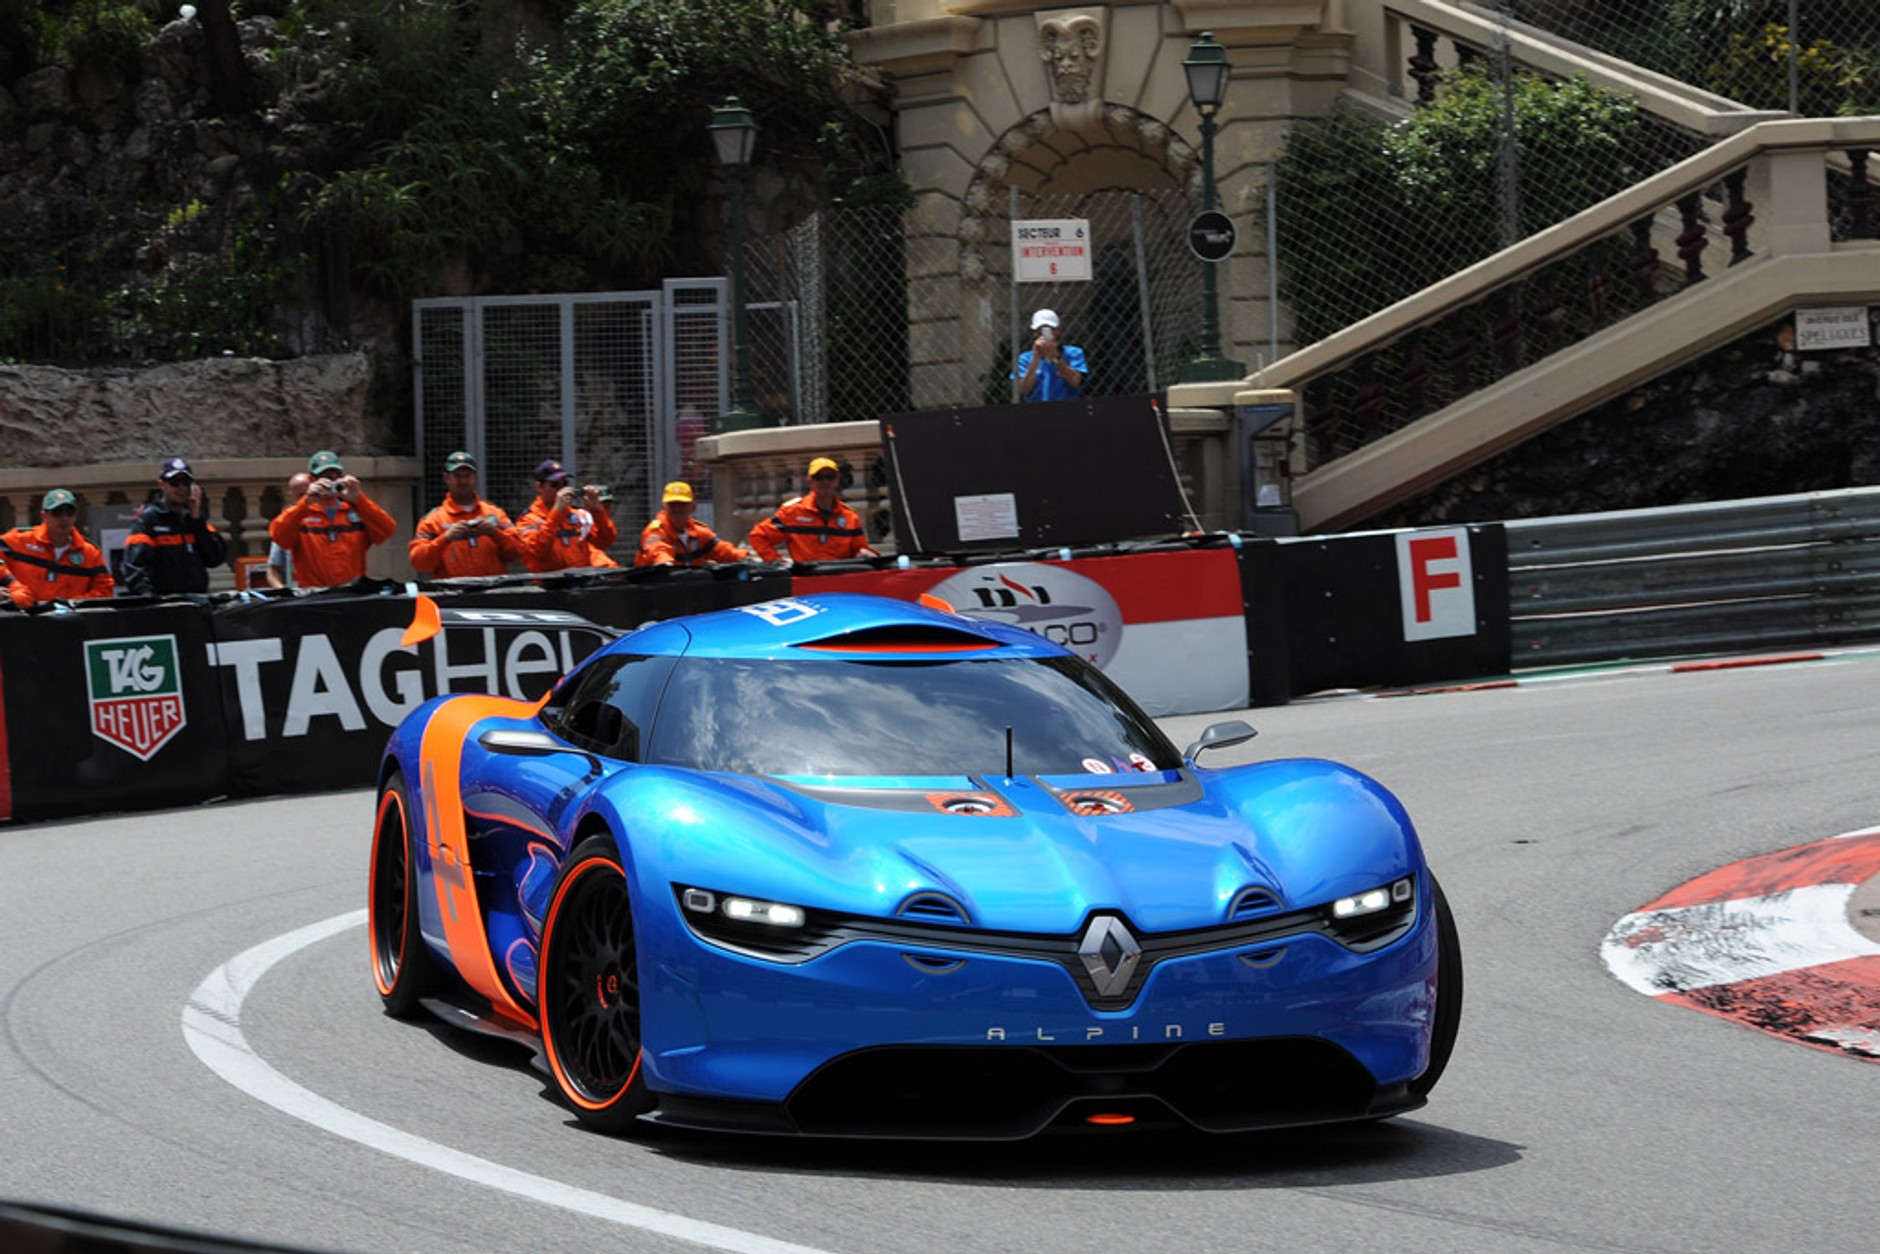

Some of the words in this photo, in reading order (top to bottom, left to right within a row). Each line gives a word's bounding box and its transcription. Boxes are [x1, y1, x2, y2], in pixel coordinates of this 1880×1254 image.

[1018, 227, 1061, 239] SECTEUR
[1075, 227, 1085, 239] 6
[1022, 246, 1085, 258] INTERVENTION
[1409, 536, 1461, 623] F
[101, 644, 165, 693] TAG
[98, 700, 180, 750] HEUER
[986, 1022, 1224, 1041] ALPINE
